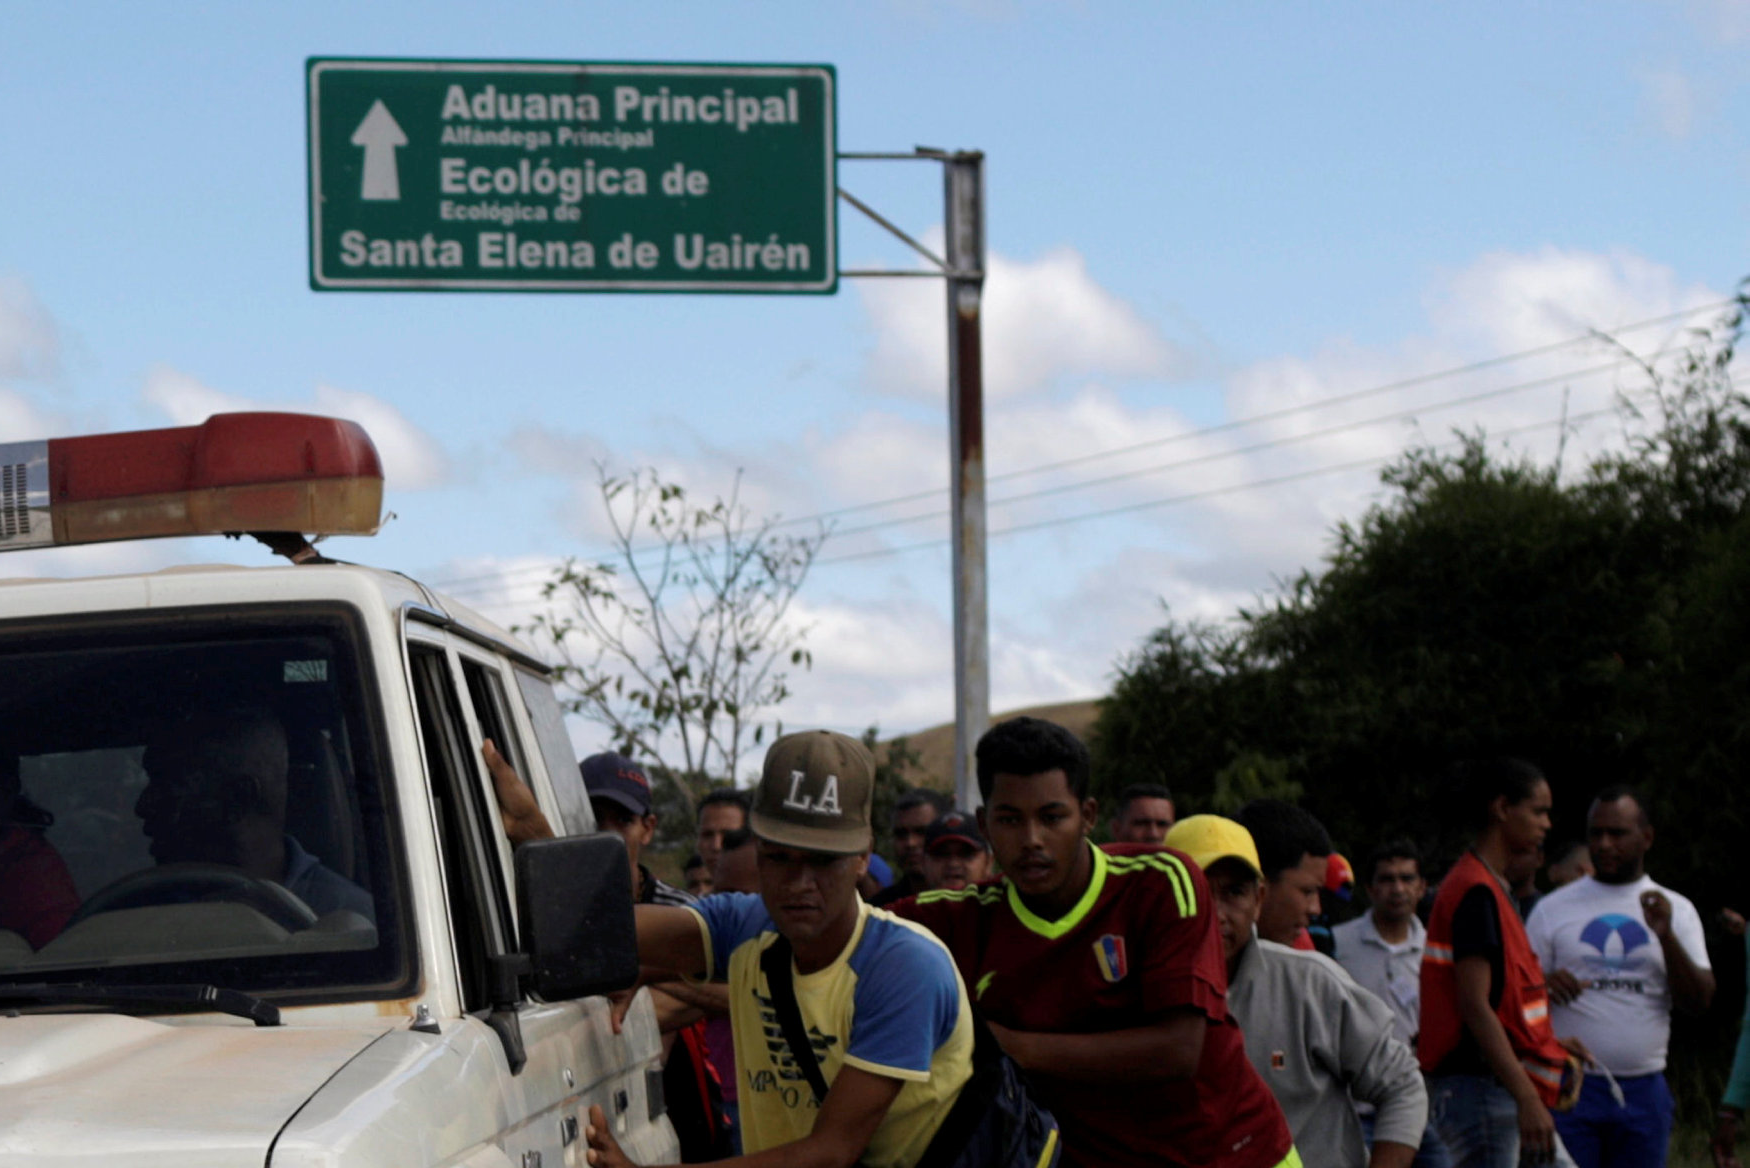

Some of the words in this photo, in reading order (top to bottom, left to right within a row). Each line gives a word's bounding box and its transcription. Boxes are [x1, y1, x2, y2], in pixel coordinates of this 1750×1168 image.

[441, 84, 600, 121] Aduana
[614, 86, 799, 132] Principal
[558, 126, 654, 150] Principal
[440, 157, 647, 203] Ecológica
[661, 162, 709, 196] de
[441, 200, 548, 226] Ecológica
[554, 202, 582, 221] de
[340, 229, 464, 268] Santa
[477, 232, 595, 269] Elena
[608, 233, 660, 269] de
[674, 233, 810, 271] Uairén
[782, 770, 843, 817] LA
